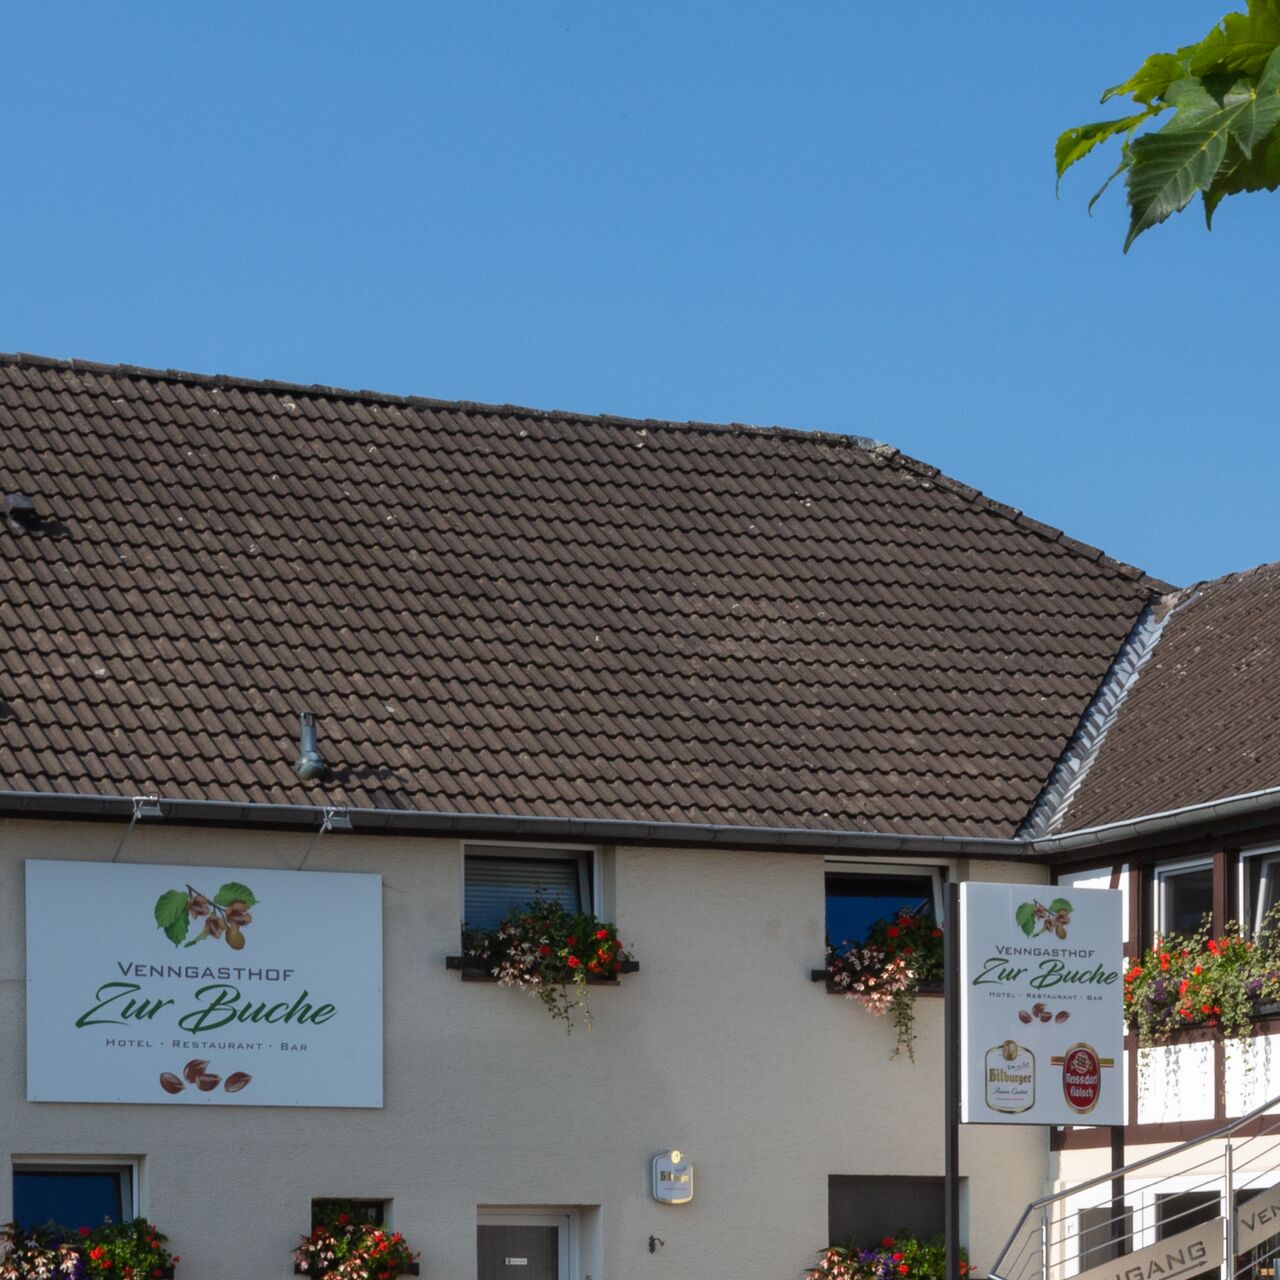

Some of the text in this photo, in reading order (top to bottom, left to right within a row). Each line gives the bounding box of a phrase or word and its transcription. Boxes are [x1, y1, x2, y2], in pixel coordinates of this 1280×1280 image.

[995, 945, 1096, 959] VENNGASTHOF
[117, 961, 296, 982] VENNGASTHOF
[972, 957, 1119, 990] Zur Buche
[74, 981, 338, 1035] Zur Buche
[105, 1037, 308, 1052] HOTEL RESTAURANT BAR
[989, 1067, 1032, 1085] Bitburger
